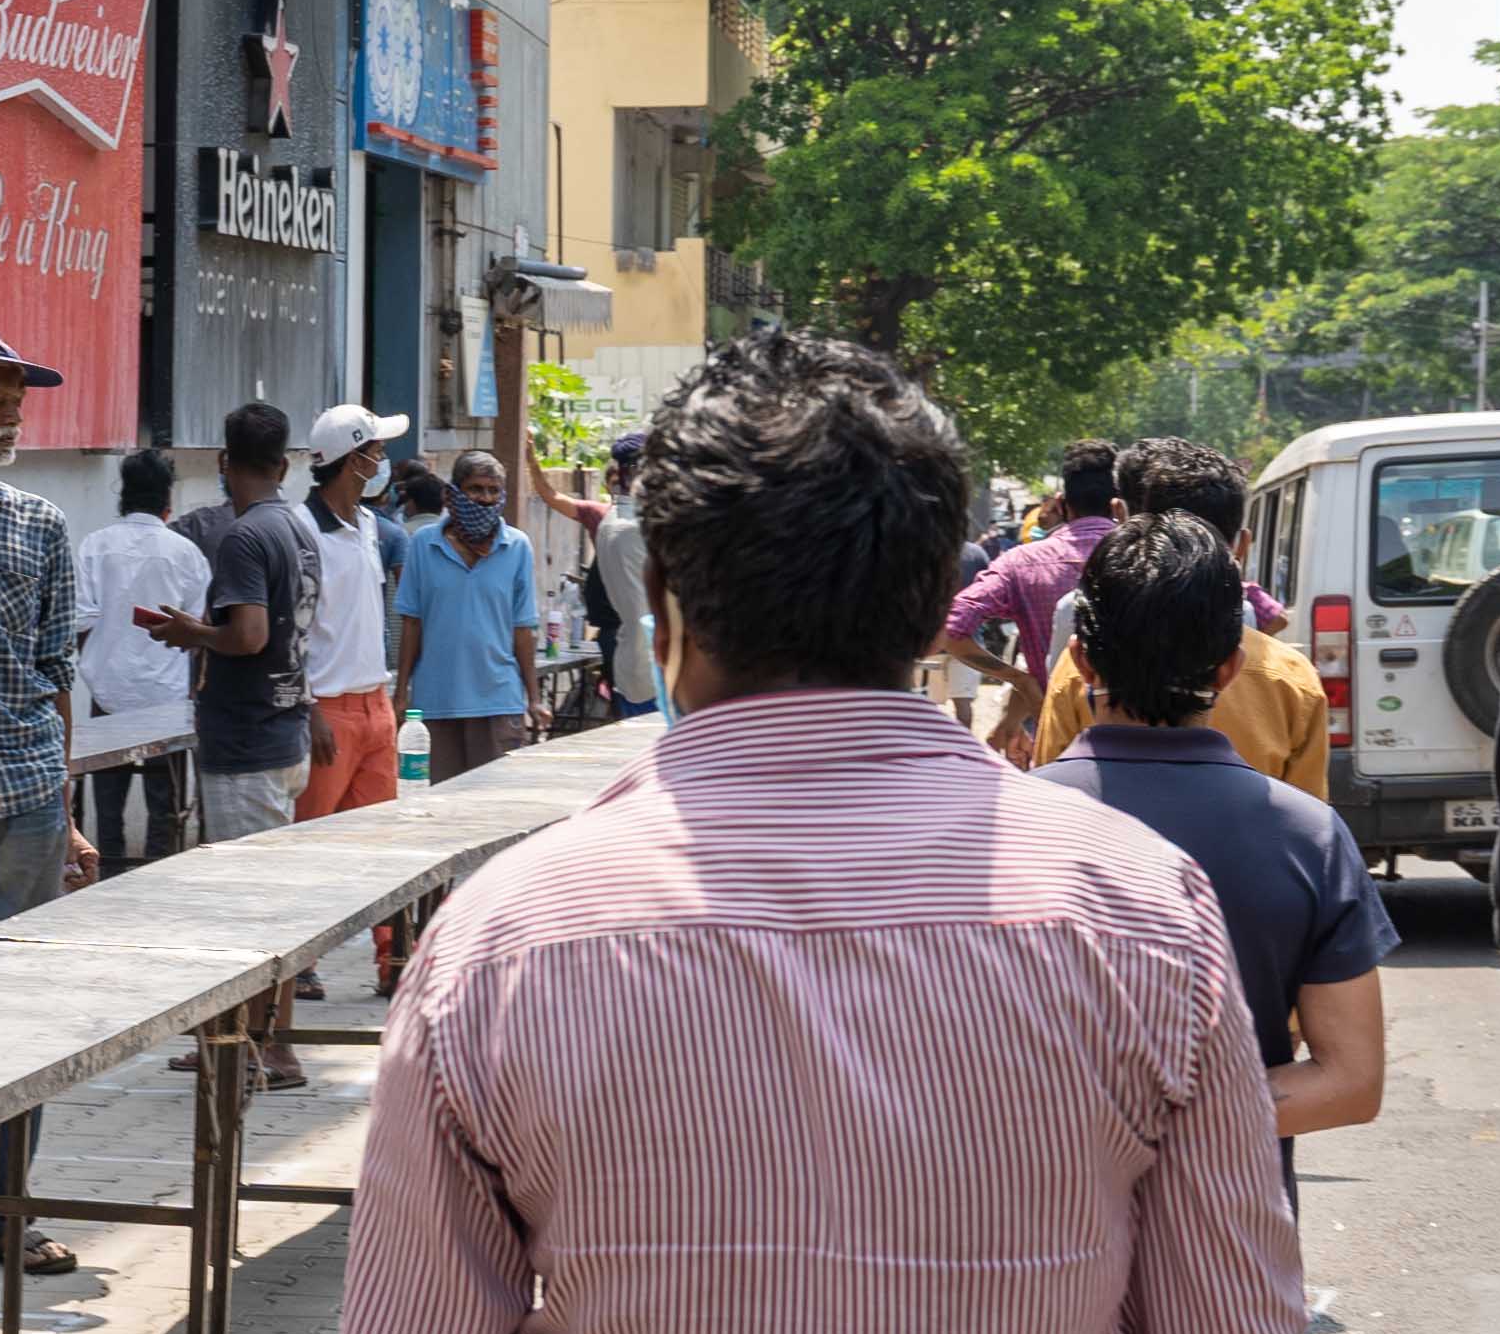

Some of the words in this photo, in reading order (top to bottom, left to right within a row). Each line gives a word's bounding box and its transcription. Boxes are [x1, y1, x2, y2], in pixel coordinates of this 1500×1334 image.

[15, 218, 35, 266] a
[34, 181, 109, 300] King
[217, 147, 337, 254] Heineken
